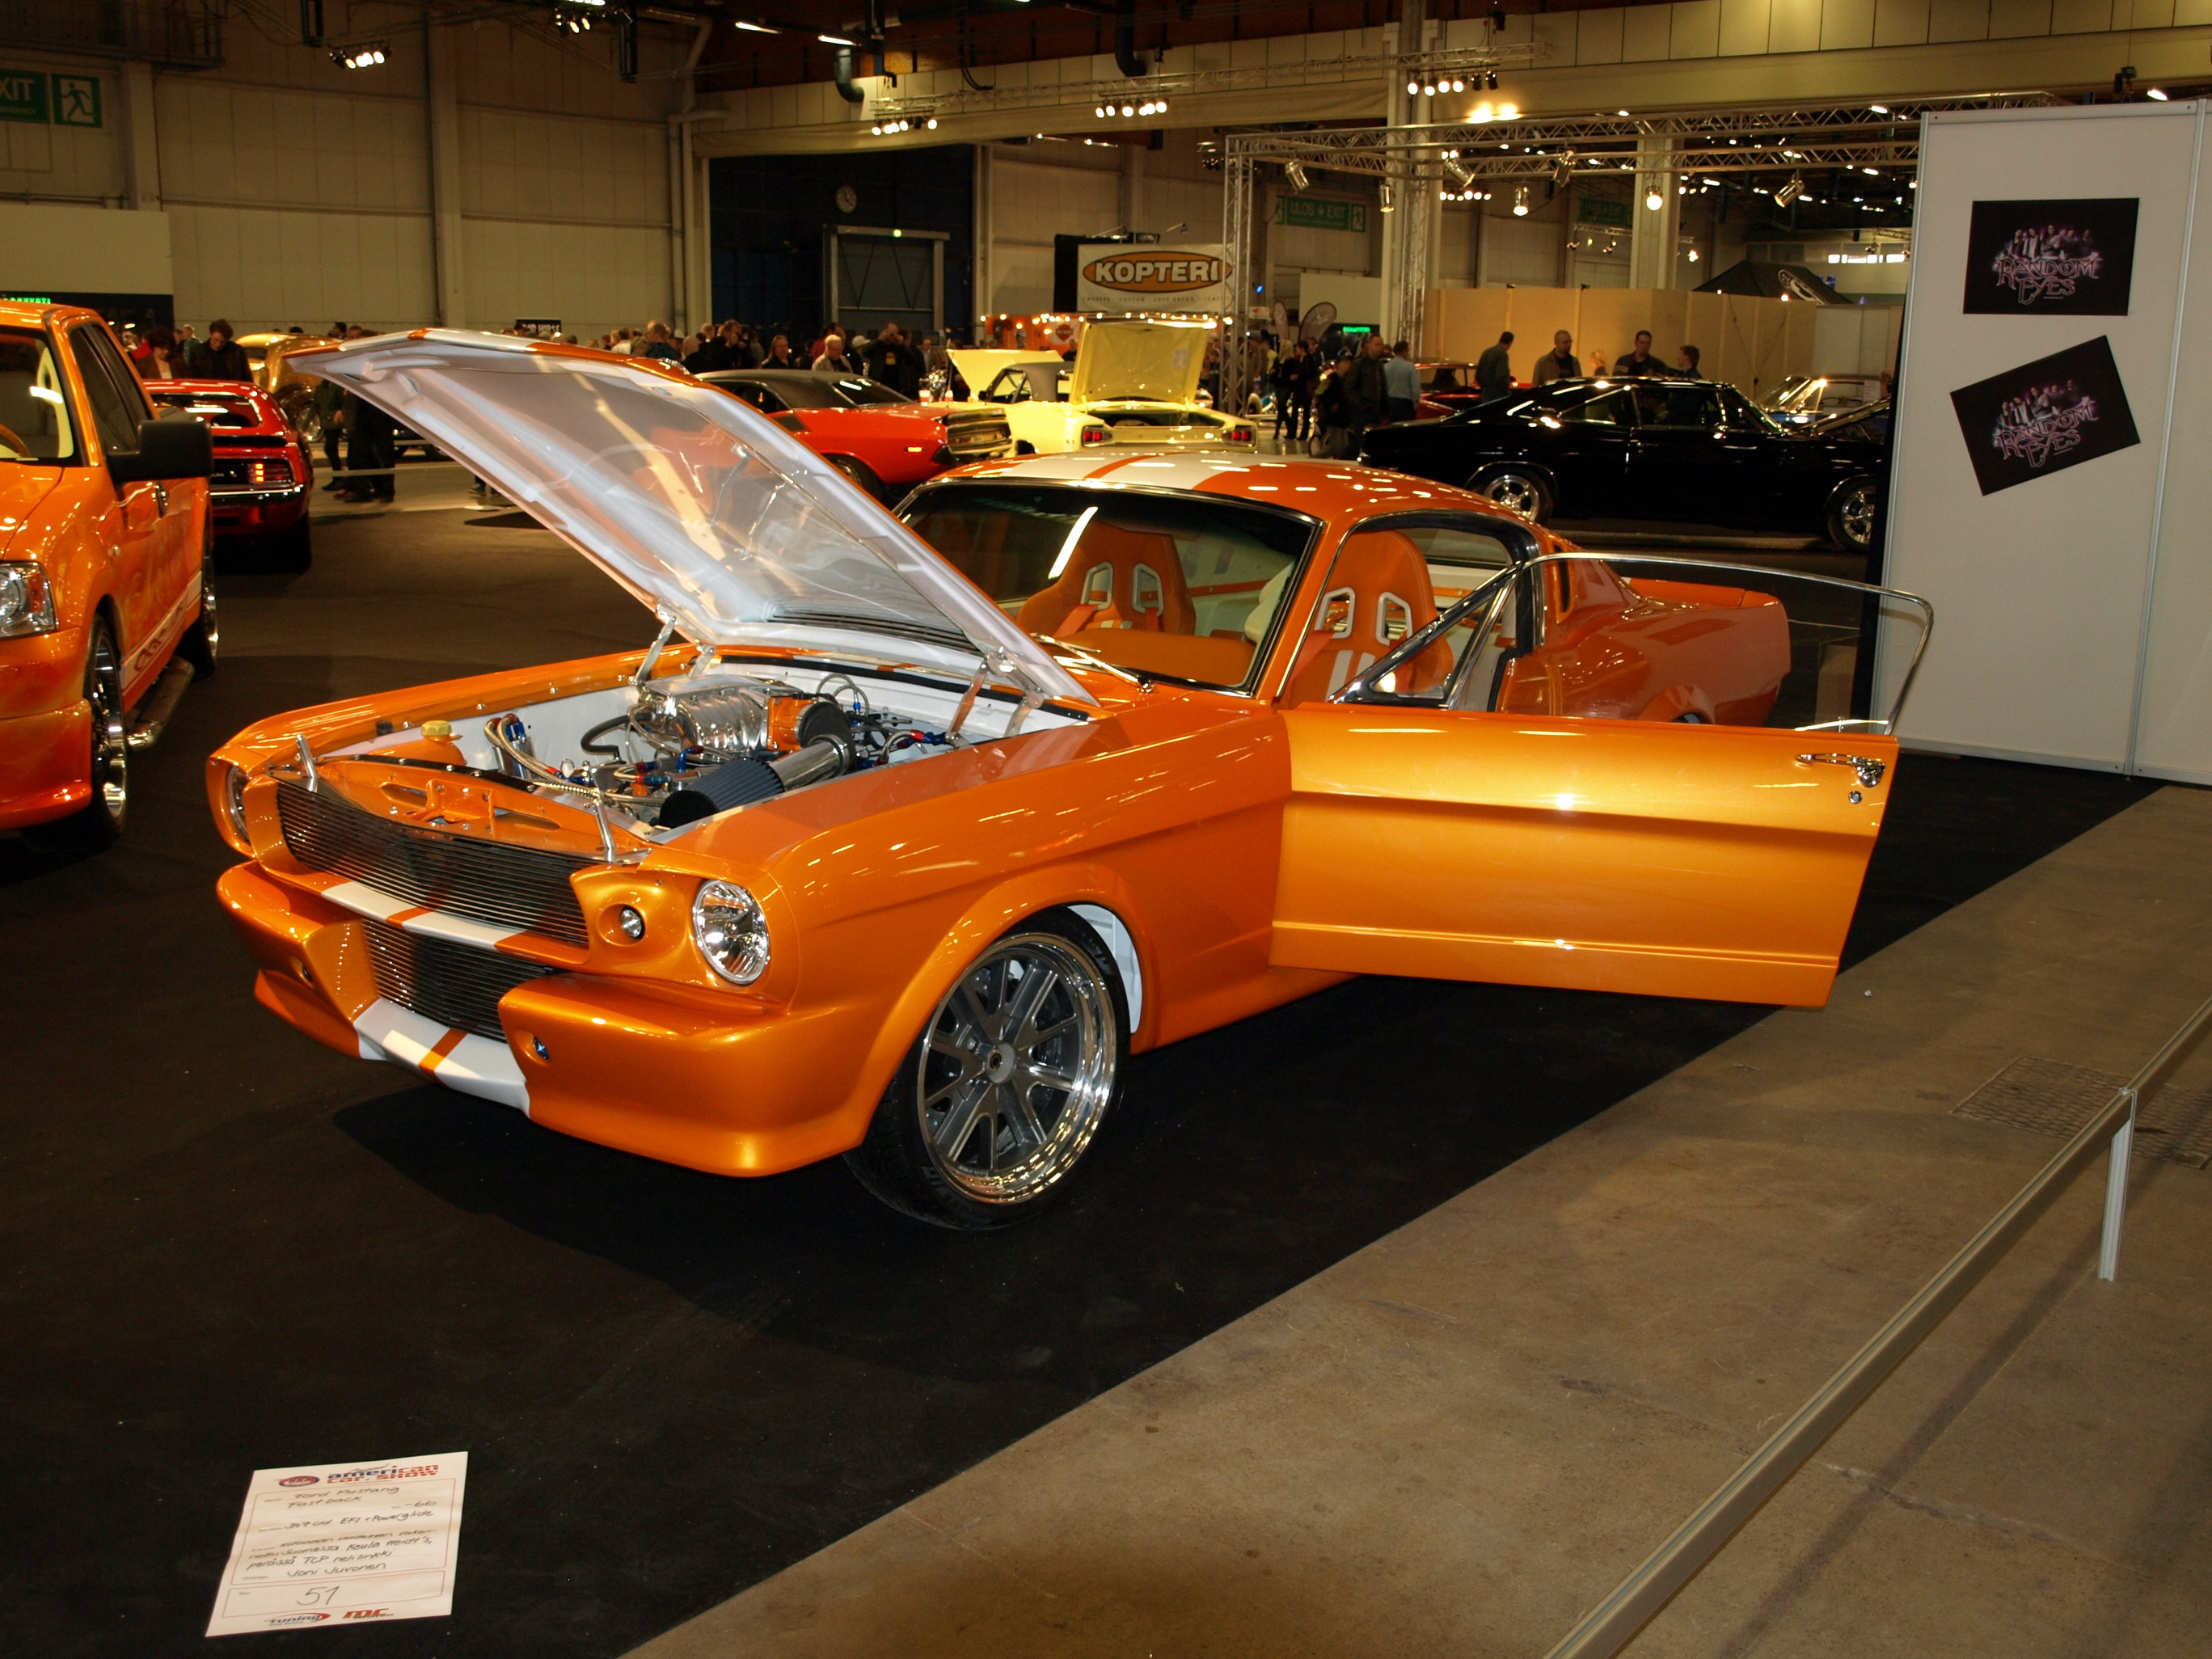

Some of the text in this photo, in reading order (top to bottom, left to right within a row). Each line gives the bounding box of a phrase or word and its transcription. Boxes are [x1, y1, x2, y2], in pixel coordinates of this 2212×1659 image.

[1290, 201, 1346, 219] ULOS EXIT
[1094, 260, 1220, 283] KOPTERI
[1995, 256, 2103, 290] RANDOM
[2015, 276, 2076, 305] EYES
[1997, 399, 2099, 460] RANDOM
[2023, 428, 2082, 469] EYES
[337, 1487, 399, 1495] Mustang
[340, 1517, 362, 1525] EFI
[304, 1556, 330, 1564] TCP
[297, 1585, 340, 1606] 51
[269, 1615, 322, 1624] tuning
